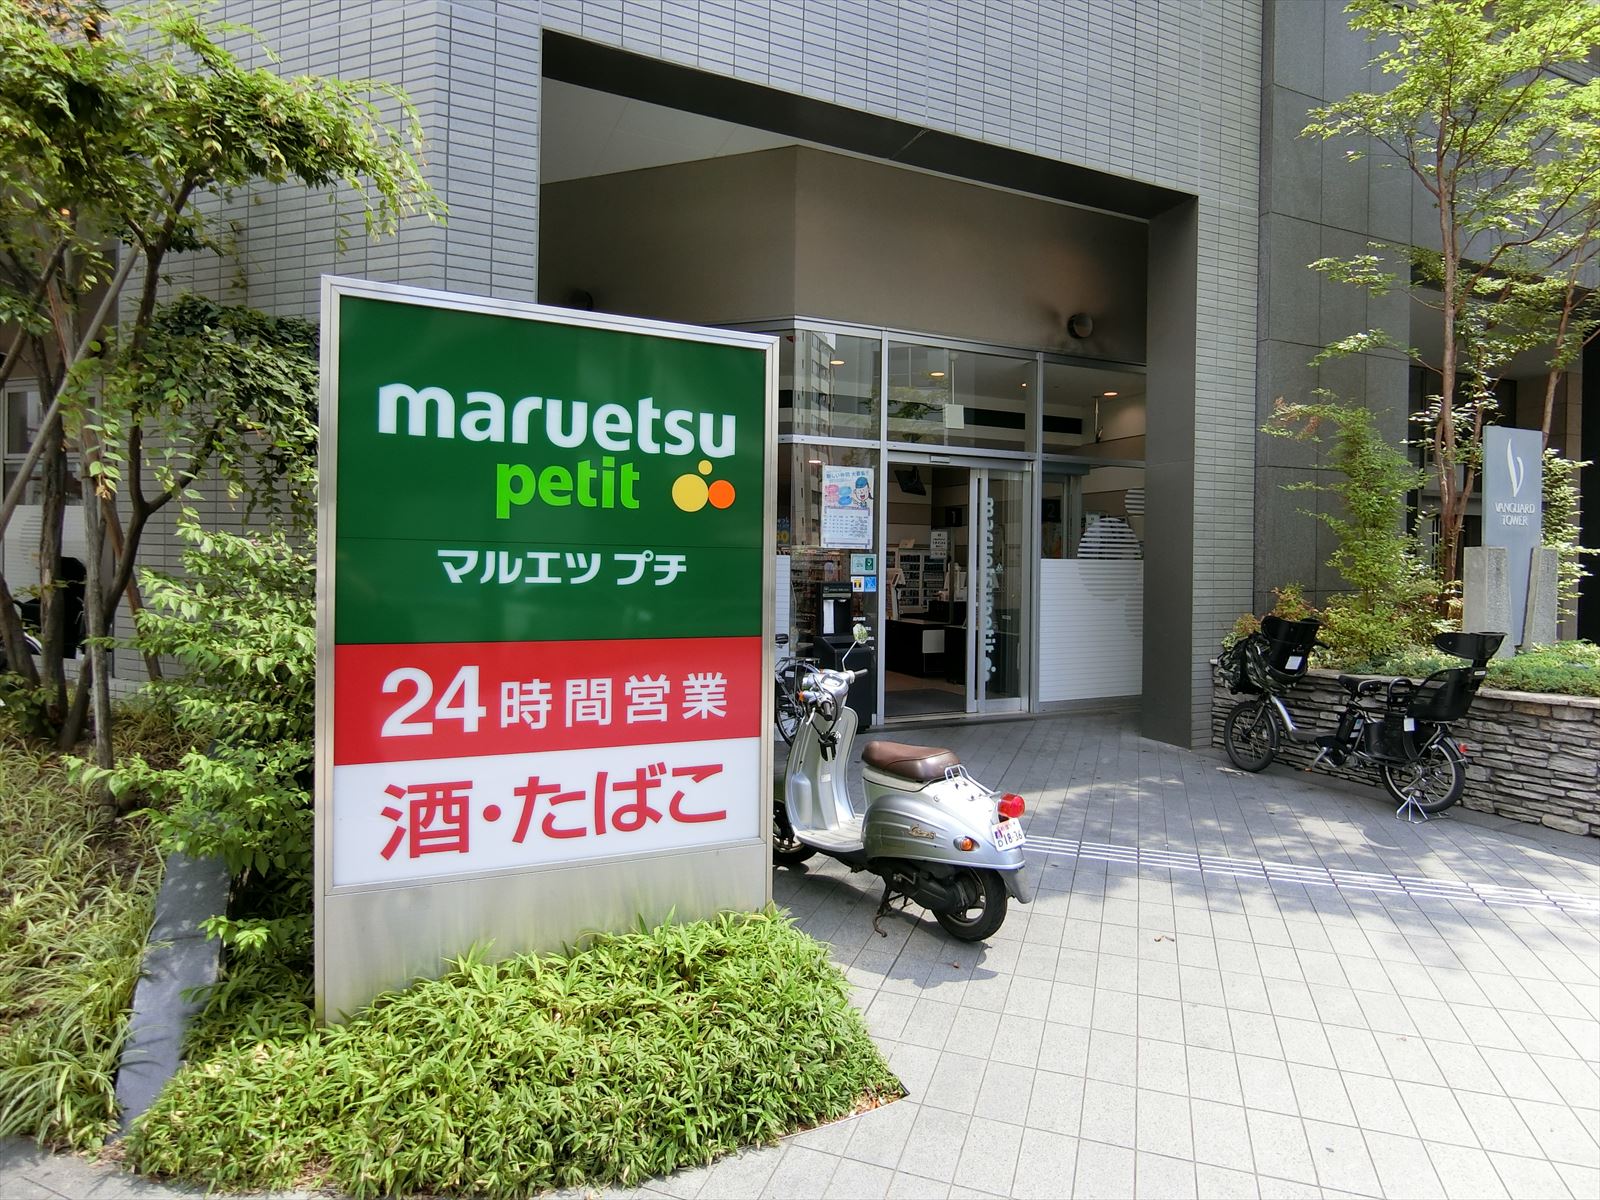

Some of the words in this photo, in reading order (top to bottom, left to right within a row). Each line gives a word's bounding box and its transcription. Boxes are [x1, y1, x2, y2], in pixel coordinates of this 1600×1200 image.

[378, 383, 736, 458] maruetsu
[496, 456, 640, 519] petit
[1494, 502, 1536, 514] VANGUARD
[1501, 514, 1529, 526] TOWER
[438, 550, 601, 585] マルエツ
[614, 550, 687, 586] プチ
[380, 665, 728, 738] 24時間営業
[380, 762, 728, 861] 酒・たばこ
